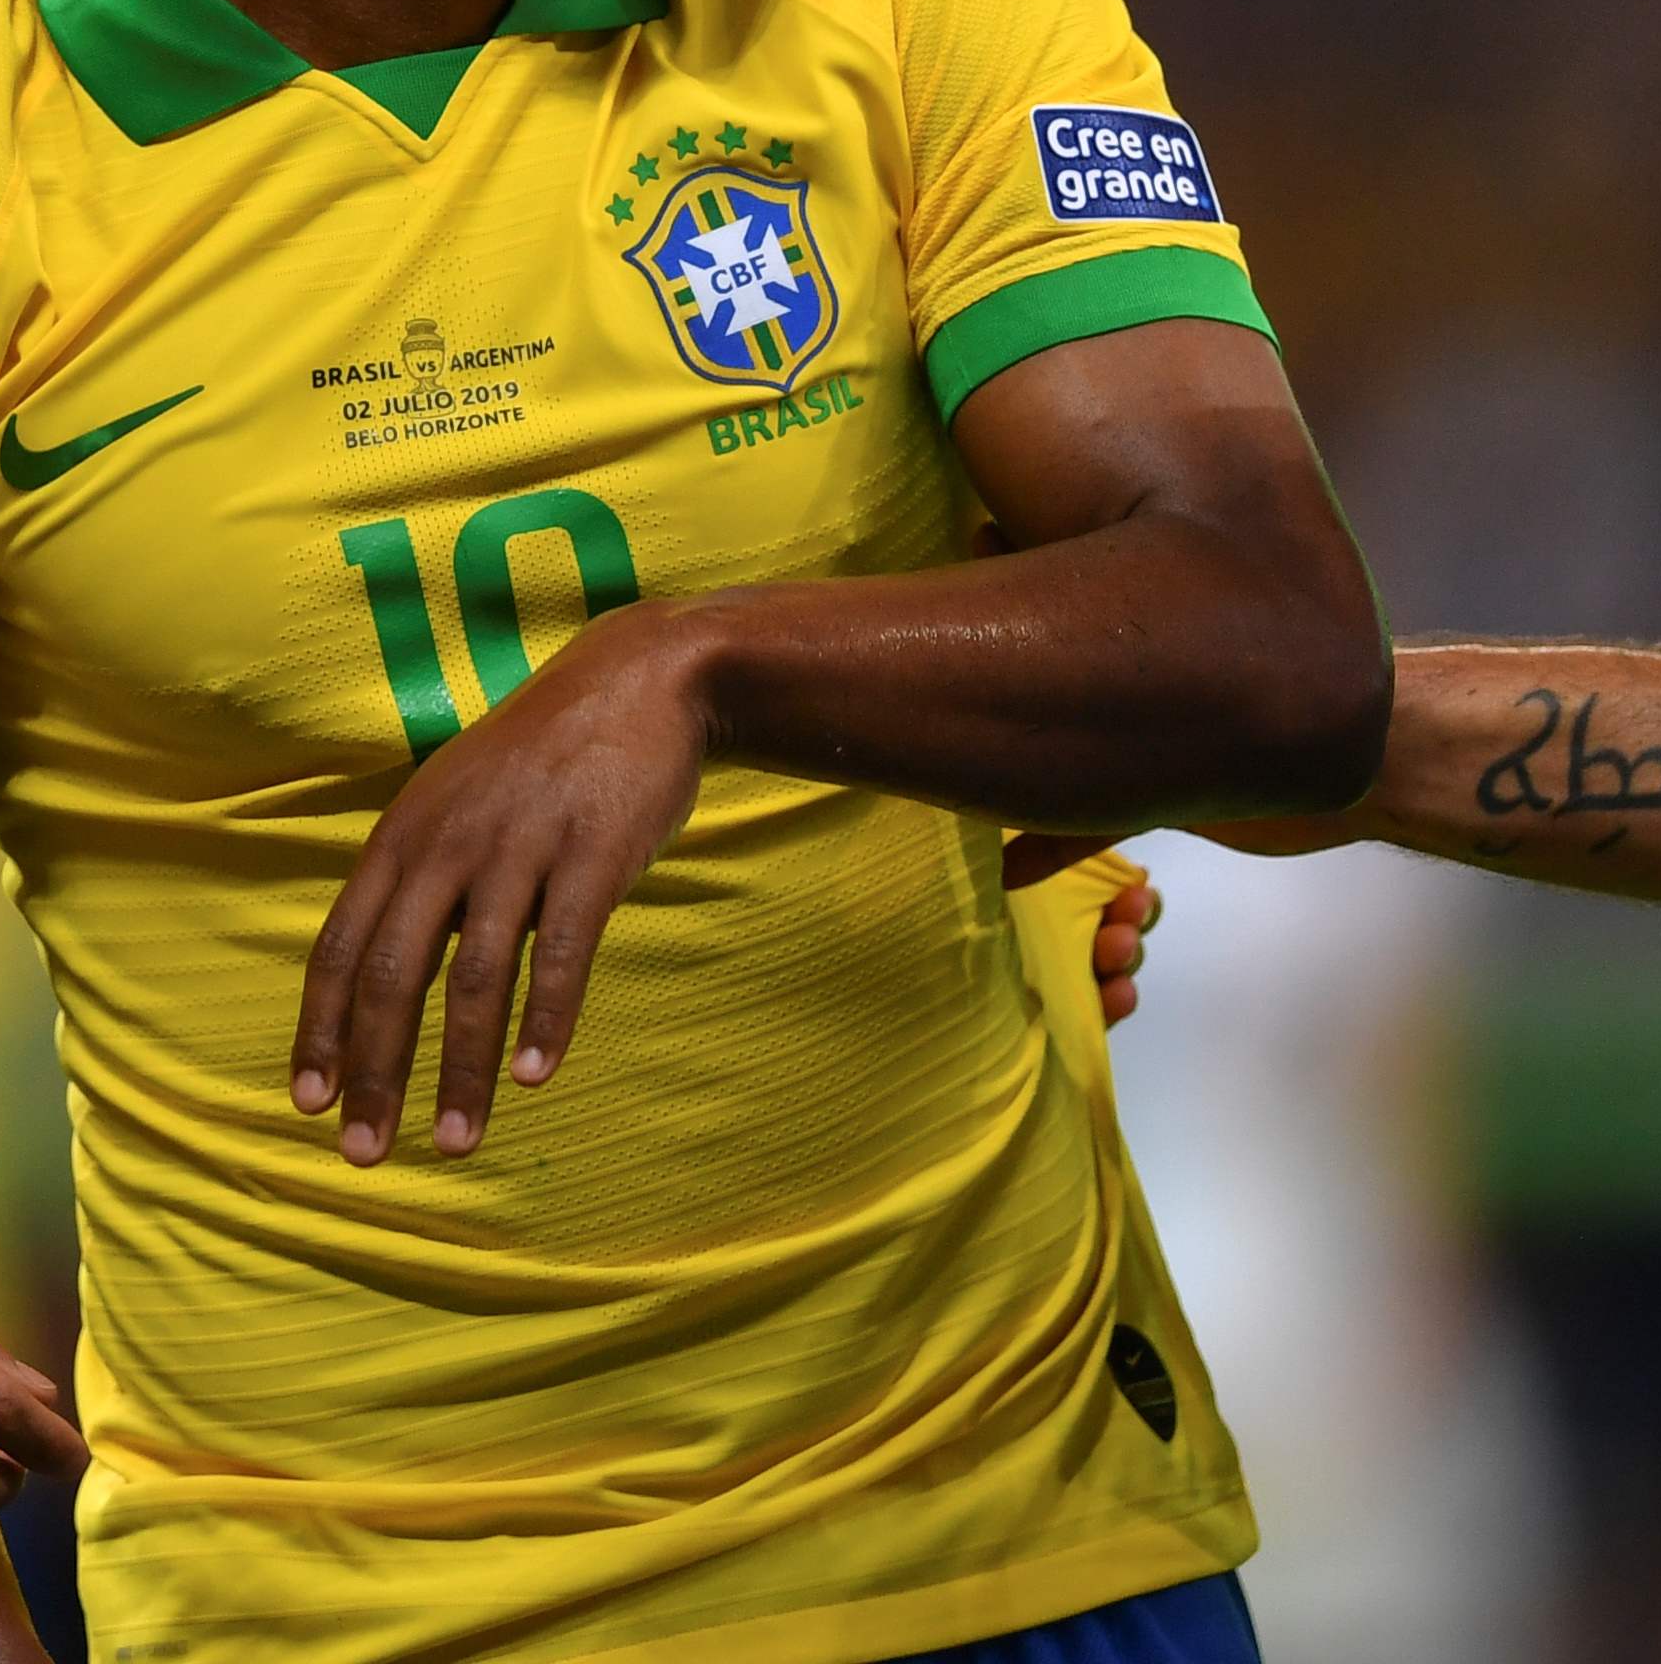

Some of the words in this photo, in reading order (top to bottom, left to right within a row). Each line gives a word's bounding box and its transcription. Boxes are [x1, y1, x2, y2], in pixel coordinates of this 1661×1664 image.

[1046, 117, 1145, 160] Cree
[1149, 134, 1195, 168] en
[710, 254, 767, 294] CBF
[311, 360, 402, 389] BRASIL
[450, 335, 556, 372] ARGENTINA
[343, 401, 372, 420] 02
[380, 390, 454, 416] JULIO
[461, 381, 520, 406] 2019
[706, 375, 864, 456] BRASIL
[345, 426, 398, 449] BELO
[405, 407, 525, 440] HORIZONTE
[338, 487, 641, 767] 10
